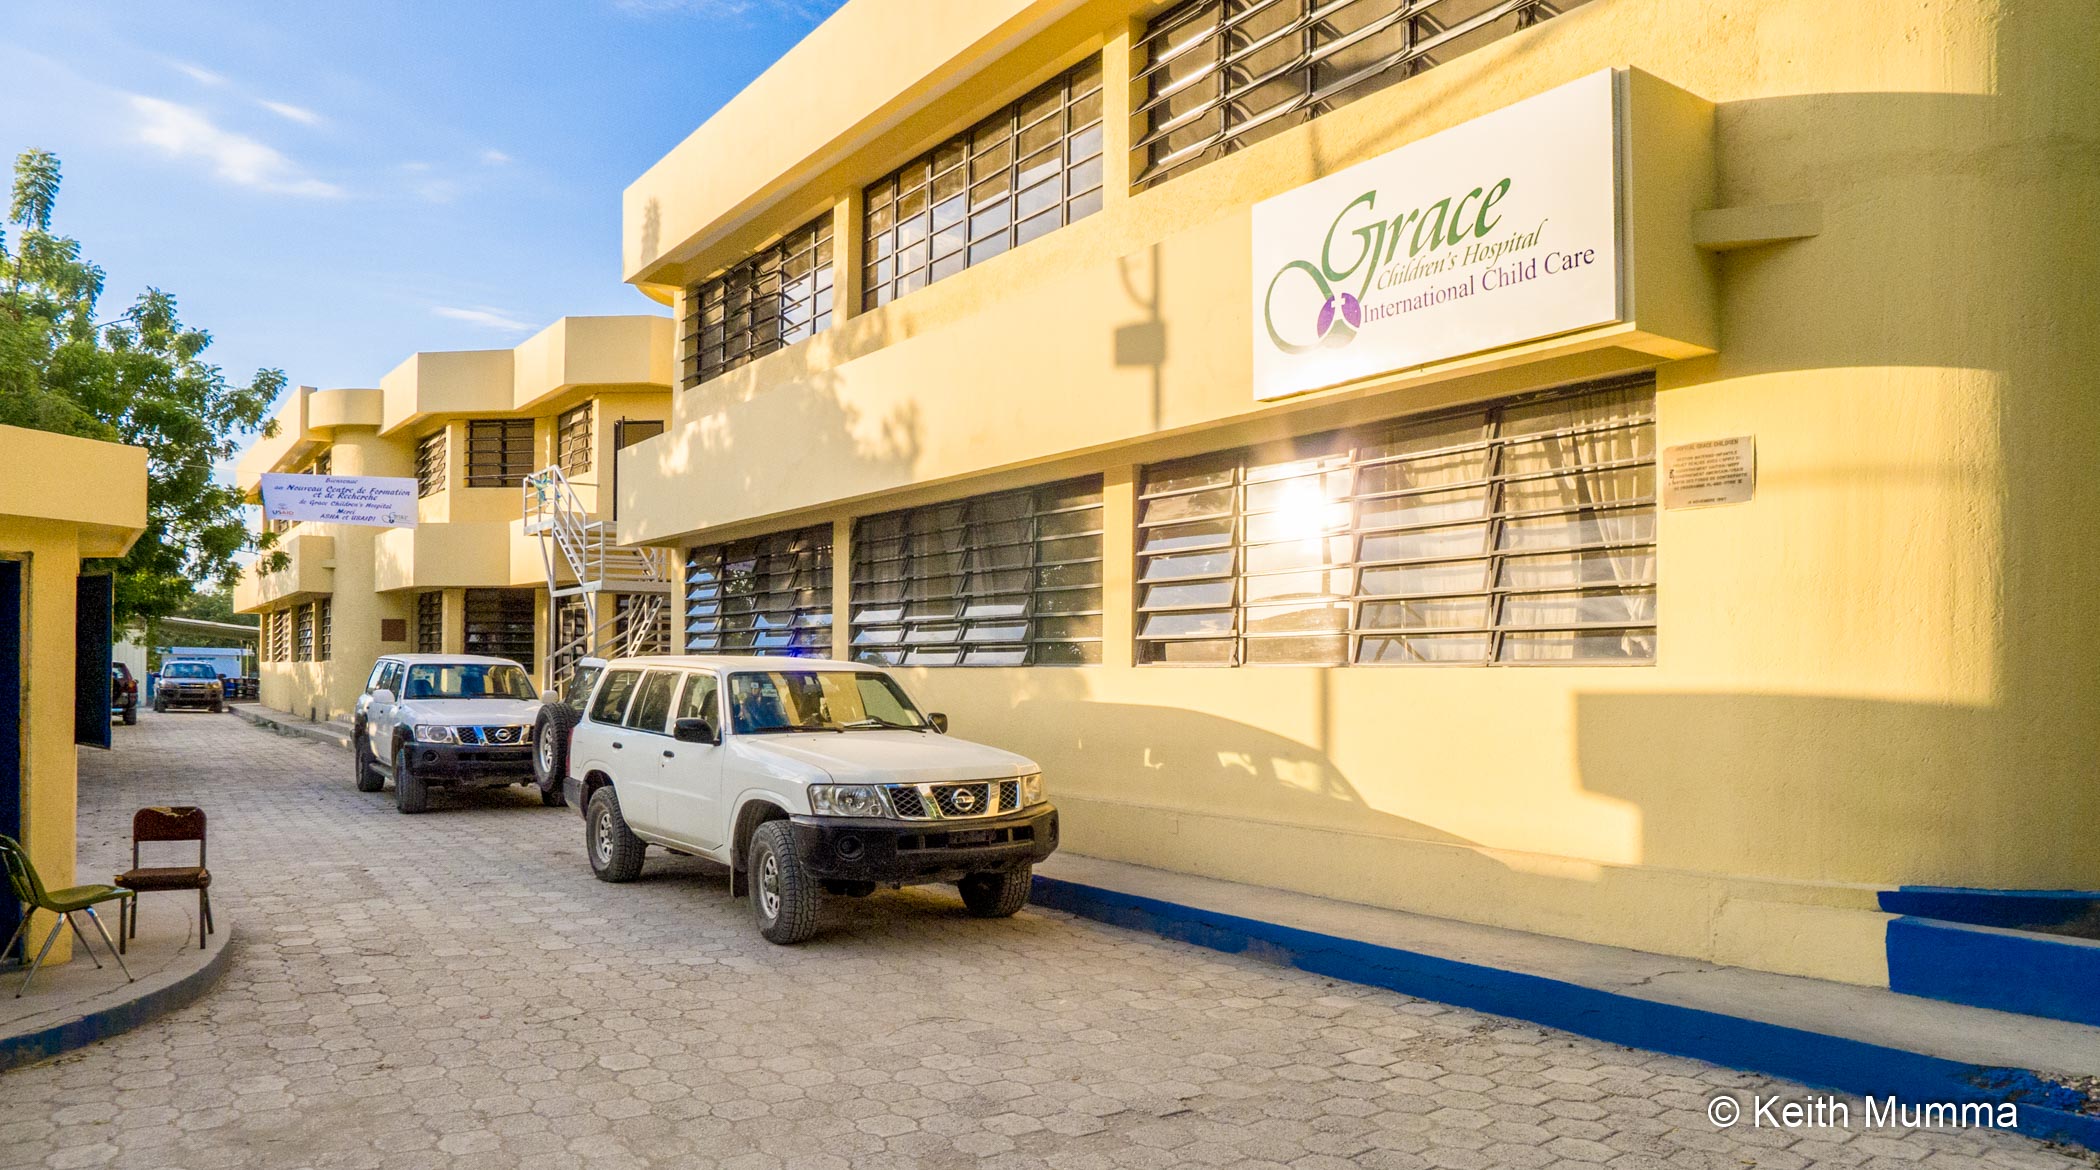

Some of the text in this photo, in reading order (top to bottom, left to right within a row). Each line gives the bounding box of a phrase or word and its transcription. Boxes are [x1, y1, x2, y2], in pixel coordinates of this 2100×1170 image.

[1321, 177, 1511, 303] Grace
[1377, 218, 1549, 292] Children's Hospital
[1363, 249, 1595, 323] International Child Care
[337, 493, 378, 501] Recherche
[370, 488, 411, 496] Formation
